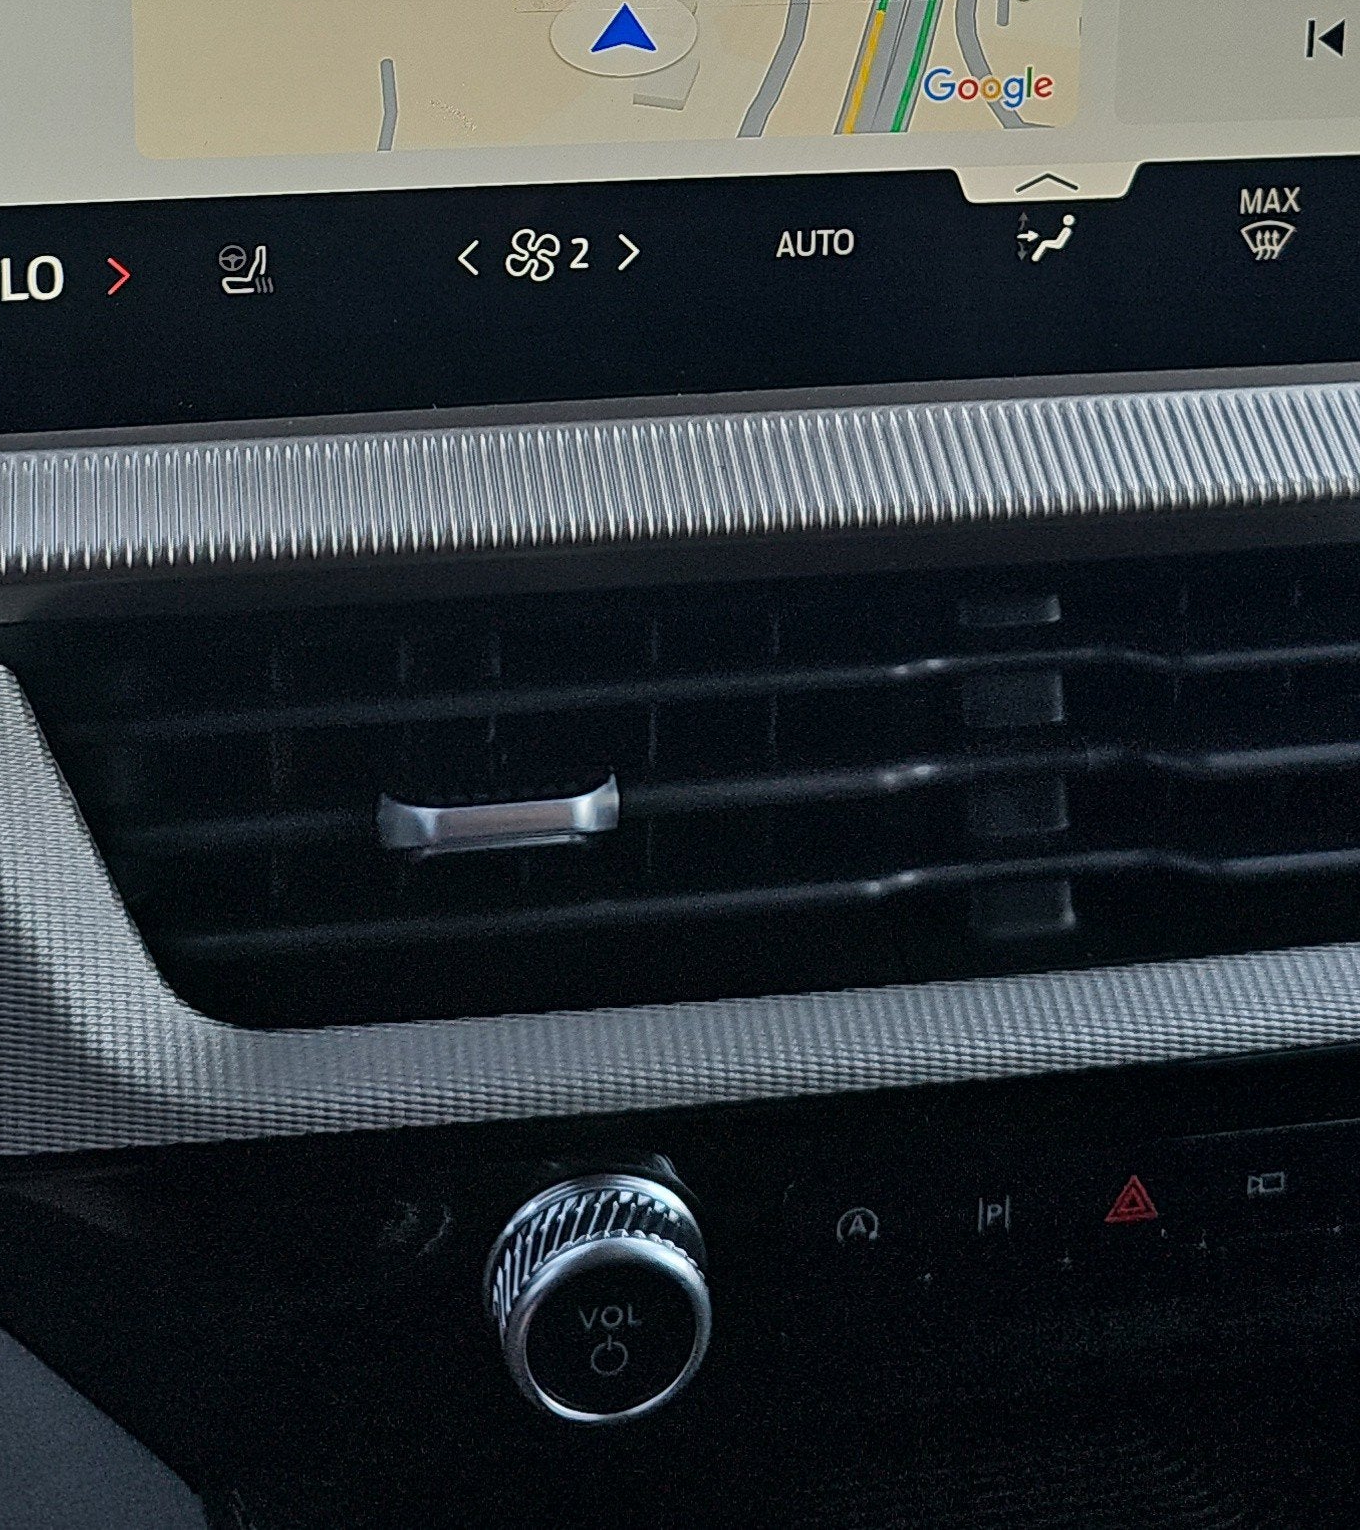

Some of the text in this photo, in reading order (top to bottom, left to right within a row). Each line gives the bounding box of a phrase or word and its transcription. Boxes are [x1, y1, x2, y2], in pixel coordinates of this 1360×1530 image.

[923, 67, 1054, 108] Google
[1240, 186, 1301, 214] MAX
[569, 238, 590, 269] 2
[776, 228, 856, 258] AUTO
[1, 255, 65, 302] LO
[579, 1303, 642, 1329] VOL
